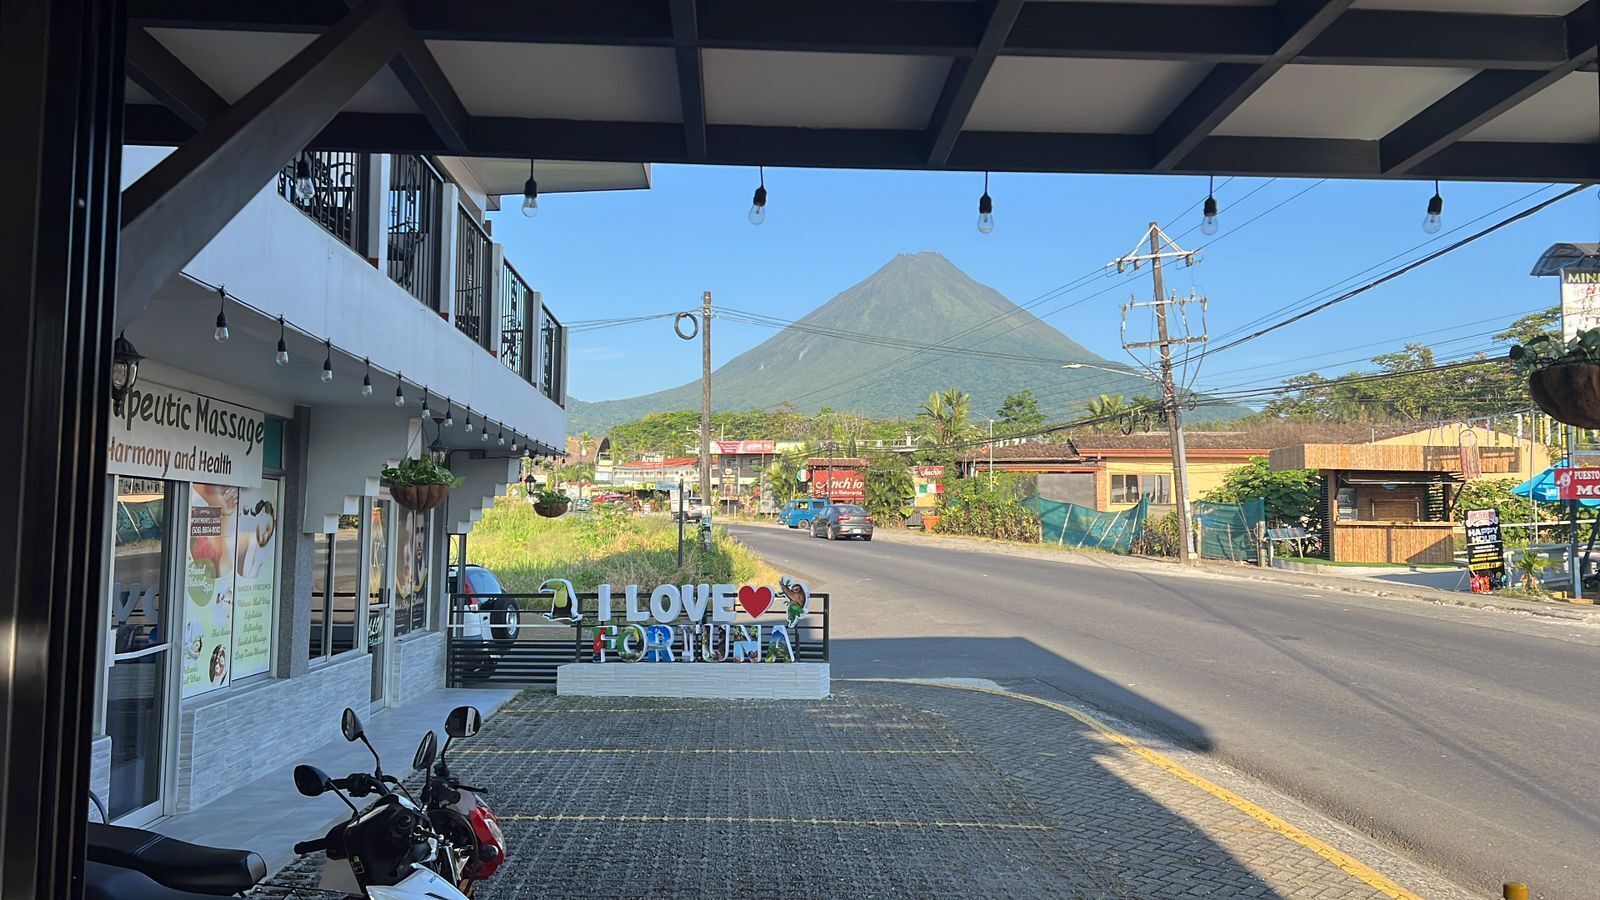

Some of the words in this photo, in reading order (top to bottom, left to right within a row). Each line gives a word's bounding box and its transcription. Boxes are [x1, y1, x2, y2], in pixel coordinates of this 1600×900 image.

[195, 397, 264, 456] Massage
[174, 446, 196, 472] and
[198, 450, 232, 475] Health
[1468, 527, 1498, 537] HAPPY
[1472, 535, 1497, 544] HOUR
[598, 583, 611, 622] I
[625, 583, 737, 623] LOVE
[591, 624, 796, 663] FORTUNA
